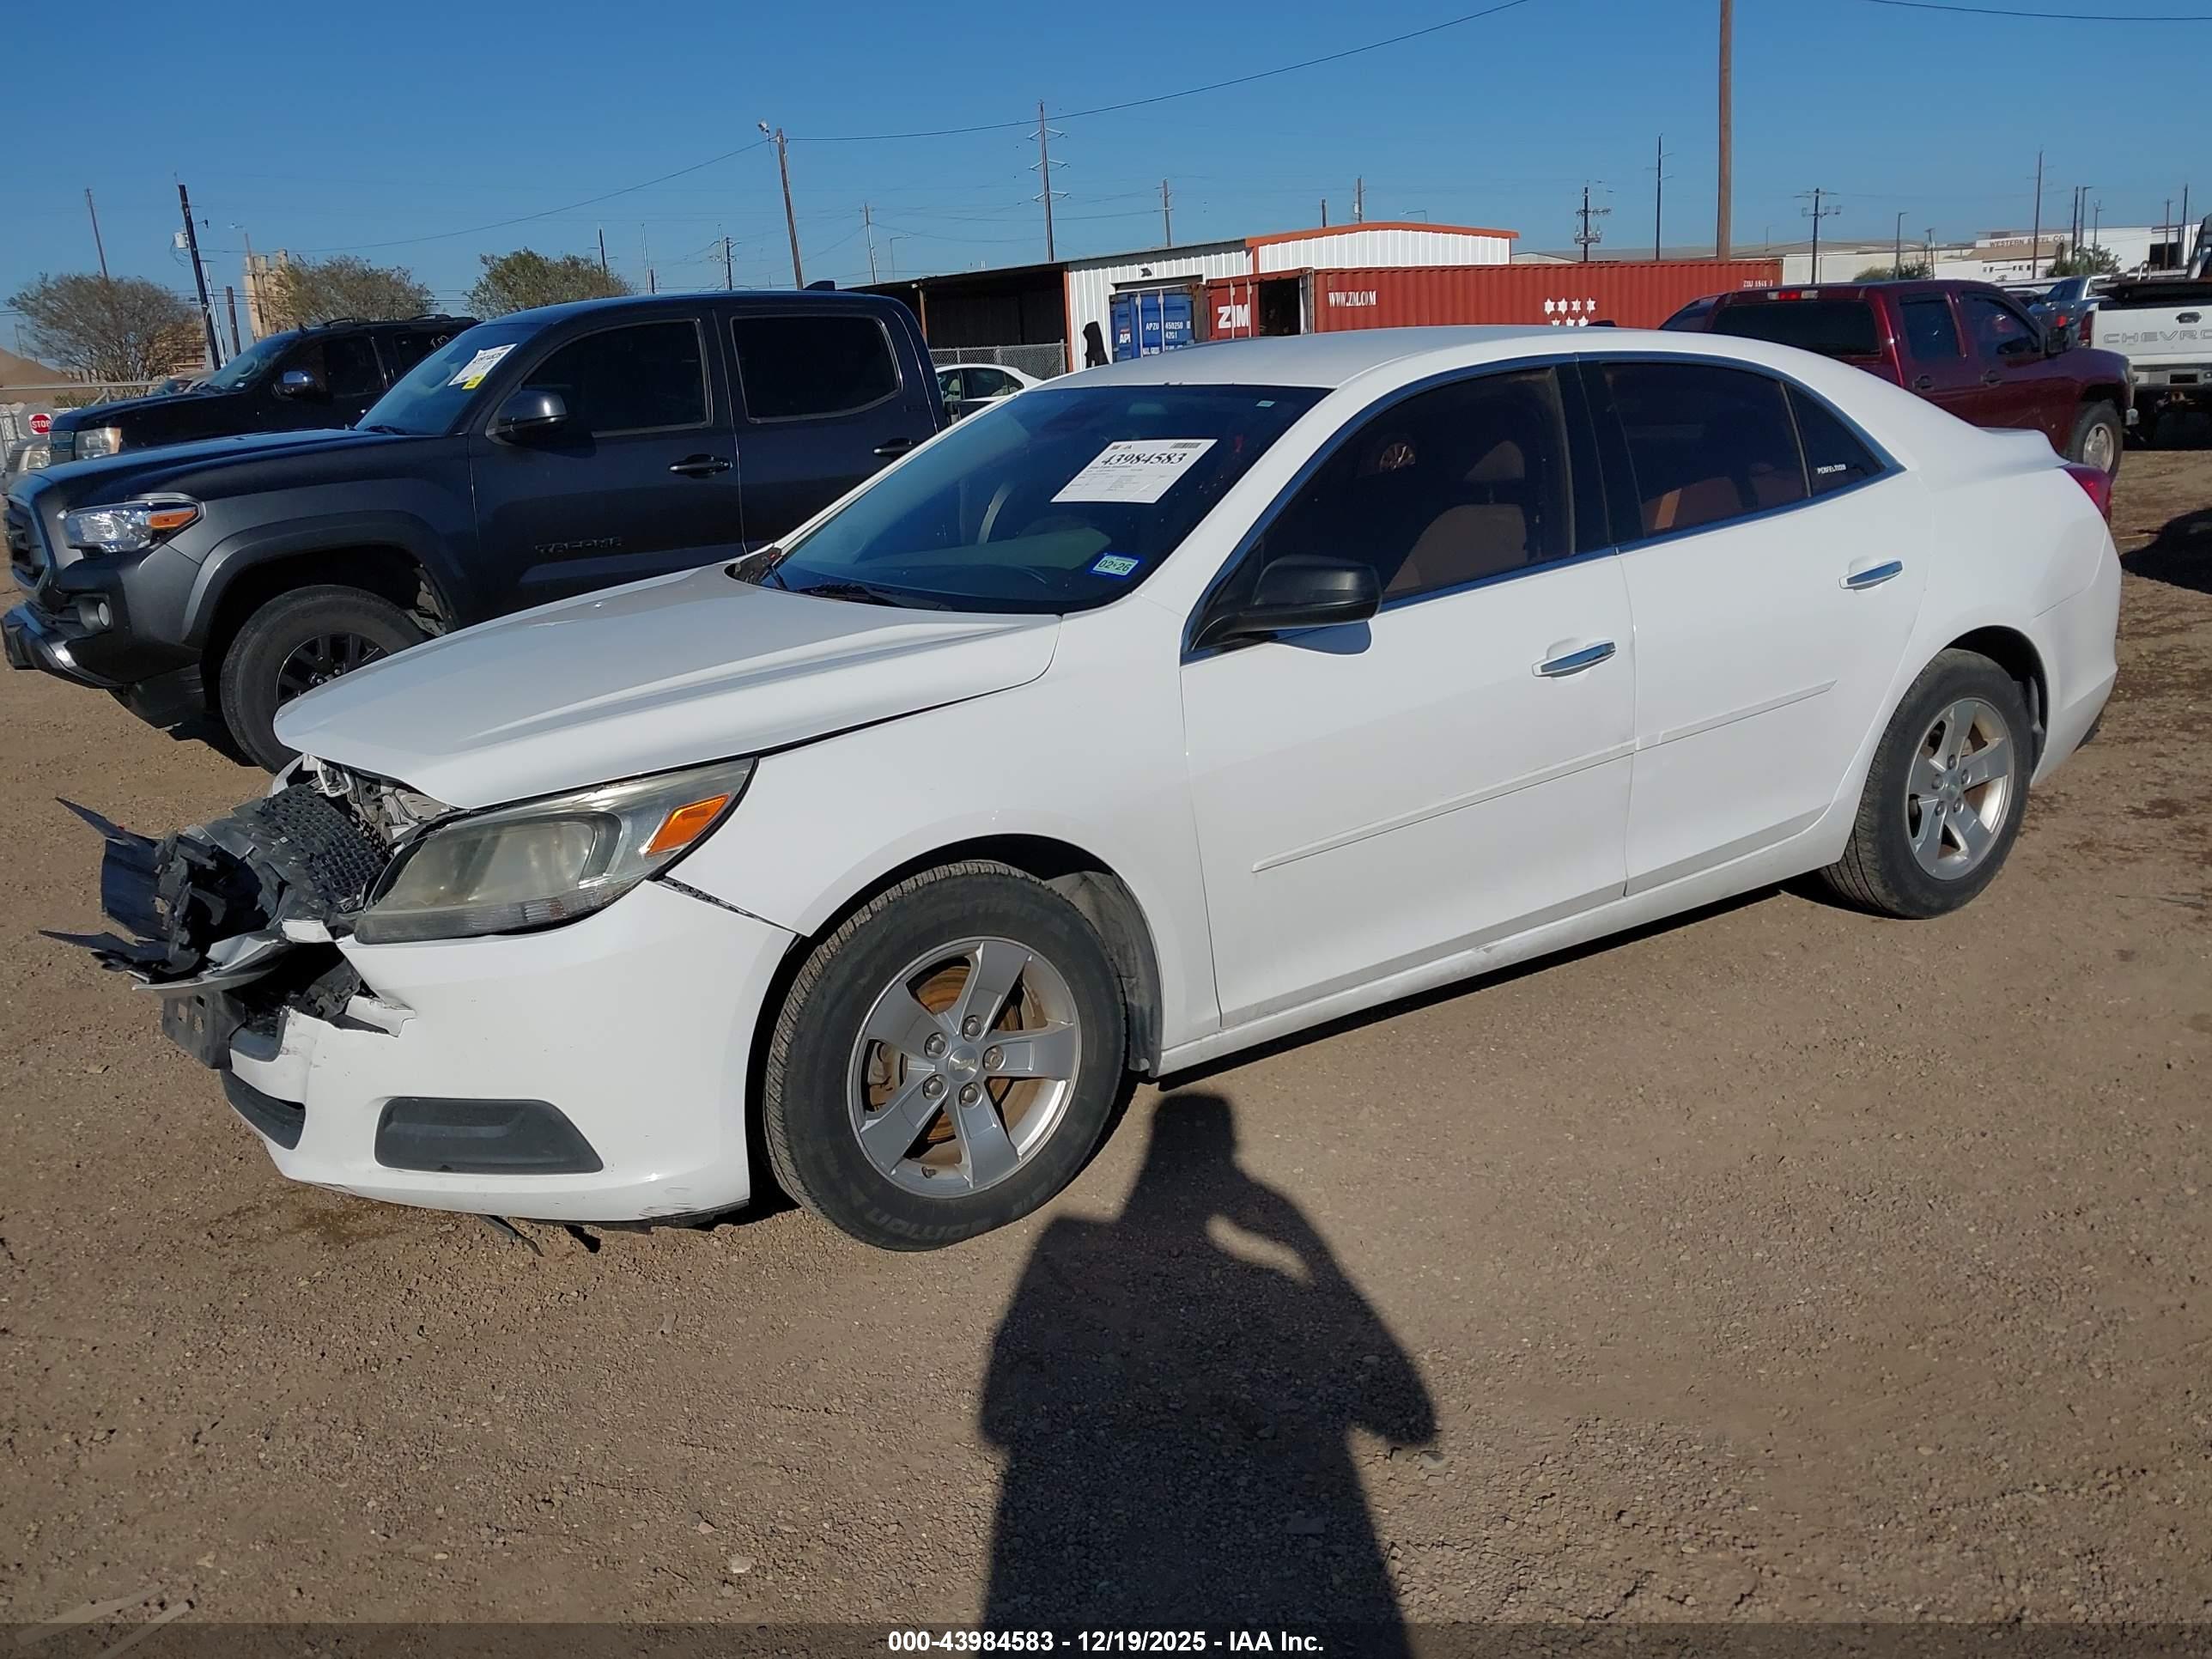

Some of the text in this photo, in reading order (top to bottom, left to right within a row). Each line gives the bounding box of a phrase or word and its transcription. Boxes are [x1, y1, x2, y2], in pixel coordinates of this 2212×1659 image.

[1218, 304, 1250, 329] ZIM
[1146, 322, 1159, 331] APZU
[32, 420, 51, 428] STOP
[1102, 453, 1188, 465] 43984583
